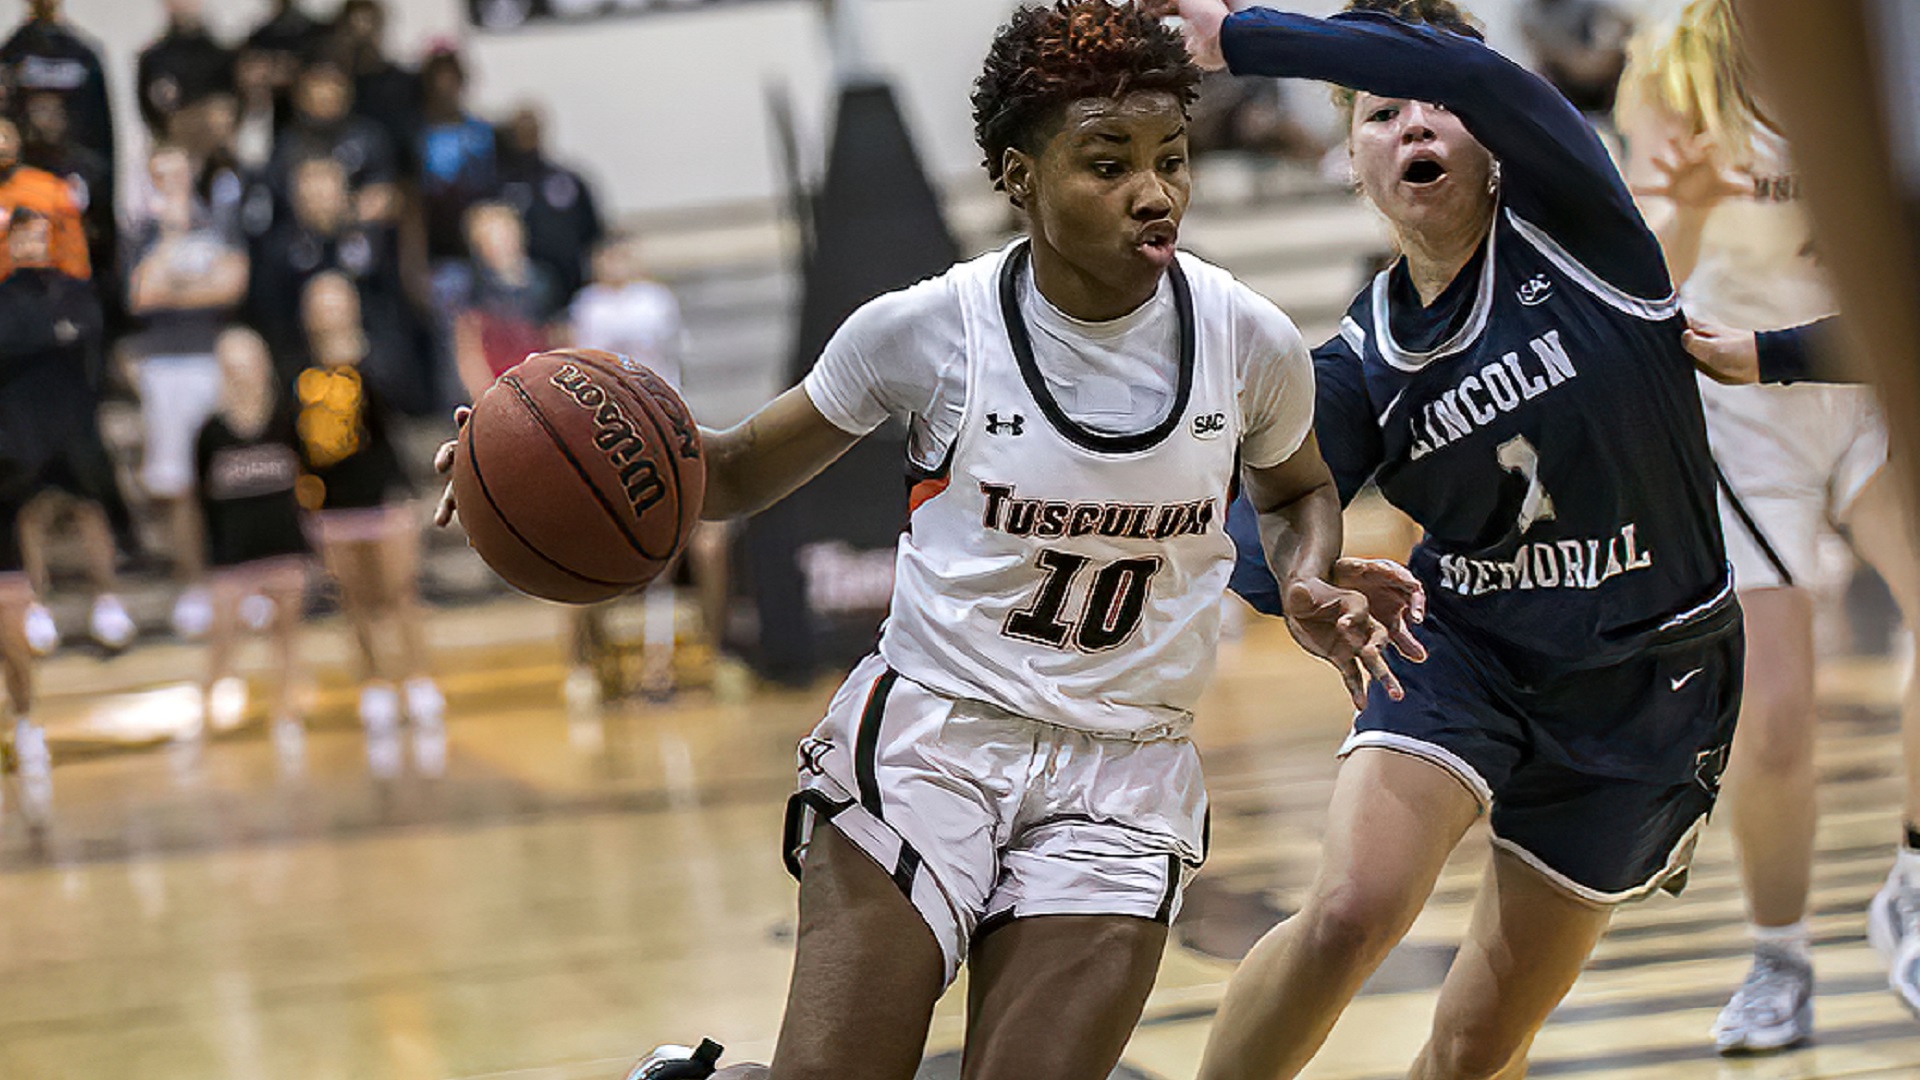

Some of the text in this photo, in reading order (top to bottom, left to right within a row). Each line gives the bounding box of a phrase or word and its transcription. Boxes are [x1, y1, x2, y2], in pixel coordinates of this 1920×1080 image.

[551, 363, 665, 518] Wilson
[1194, 412, 1225, 434] SAC
[1001, 549, 1162, 655] 10
[1440, 523, 1652, 595] MEMORIAL
